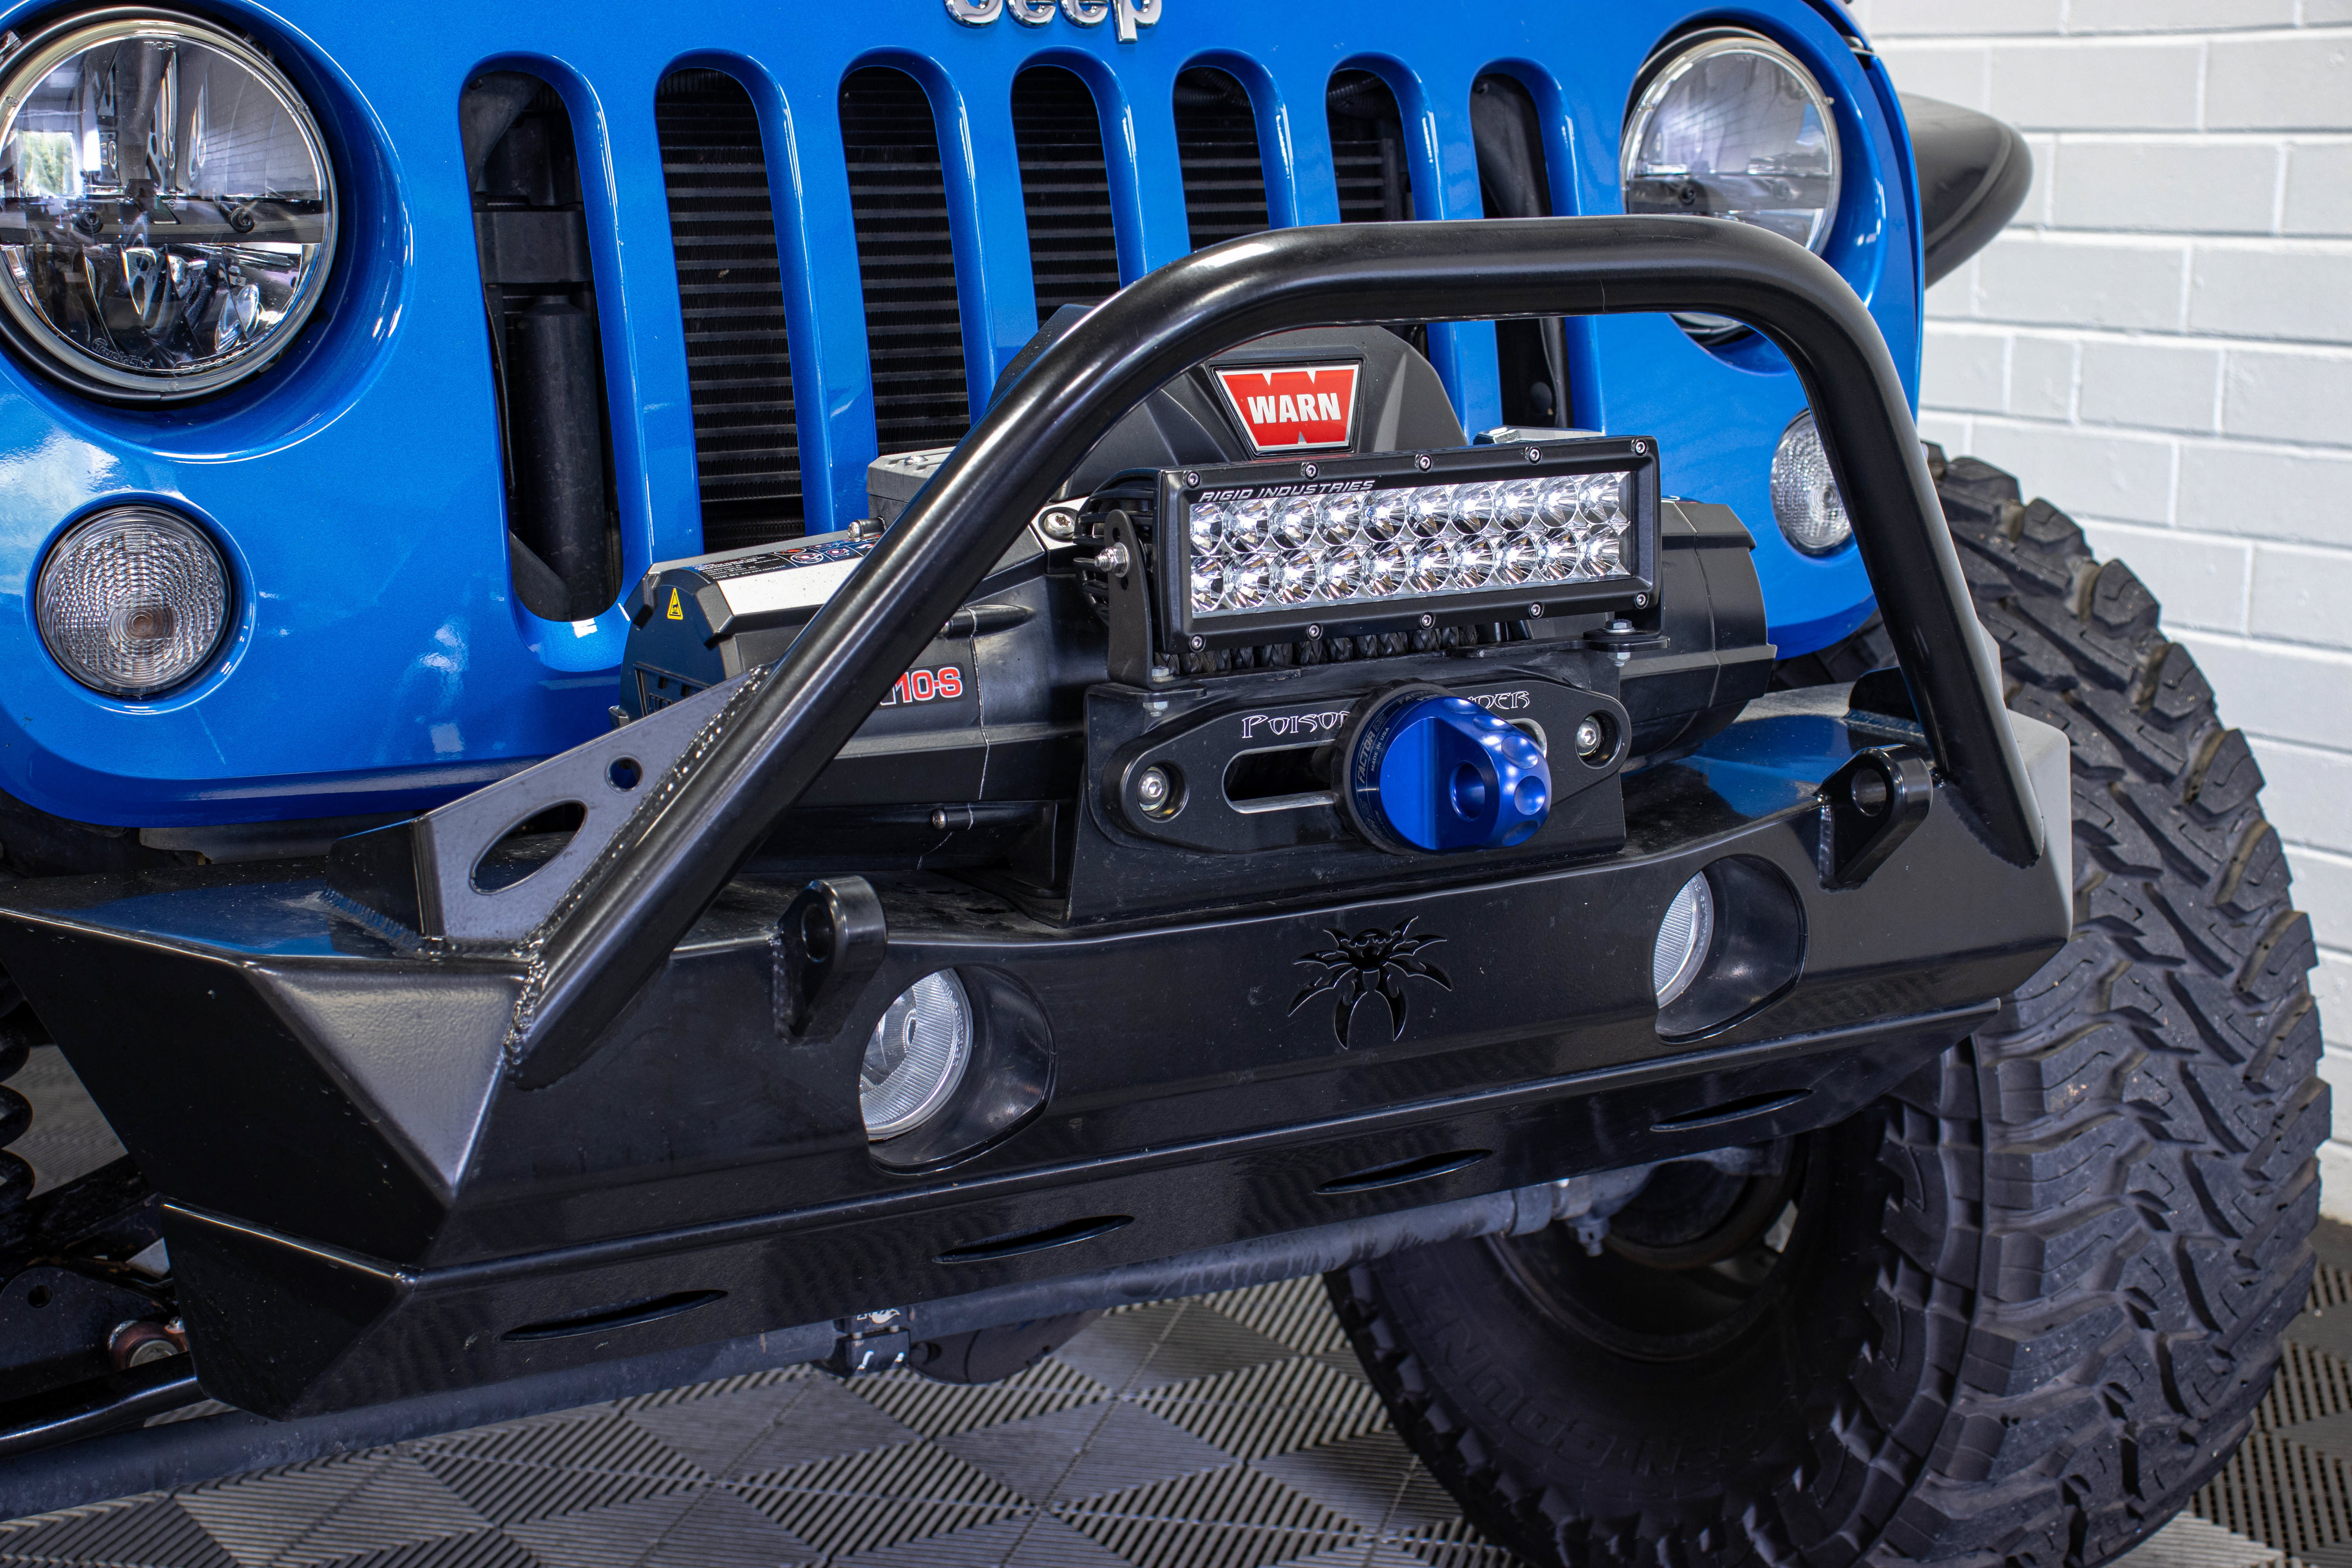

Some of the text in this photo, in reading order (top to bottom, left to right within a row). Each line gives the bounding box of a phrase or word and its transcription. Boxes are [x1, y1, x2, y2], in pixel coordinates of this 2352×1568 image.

[143, 41, 176, 50] TOP
[1247, 392, 1341, 424] WARN
[1199, 480, 1375, 503] RIGID INDUSTRIES
[1357, 730, 1376, 784] FACTOR
[1371, 727, 1390, 772] MADE IN USA
